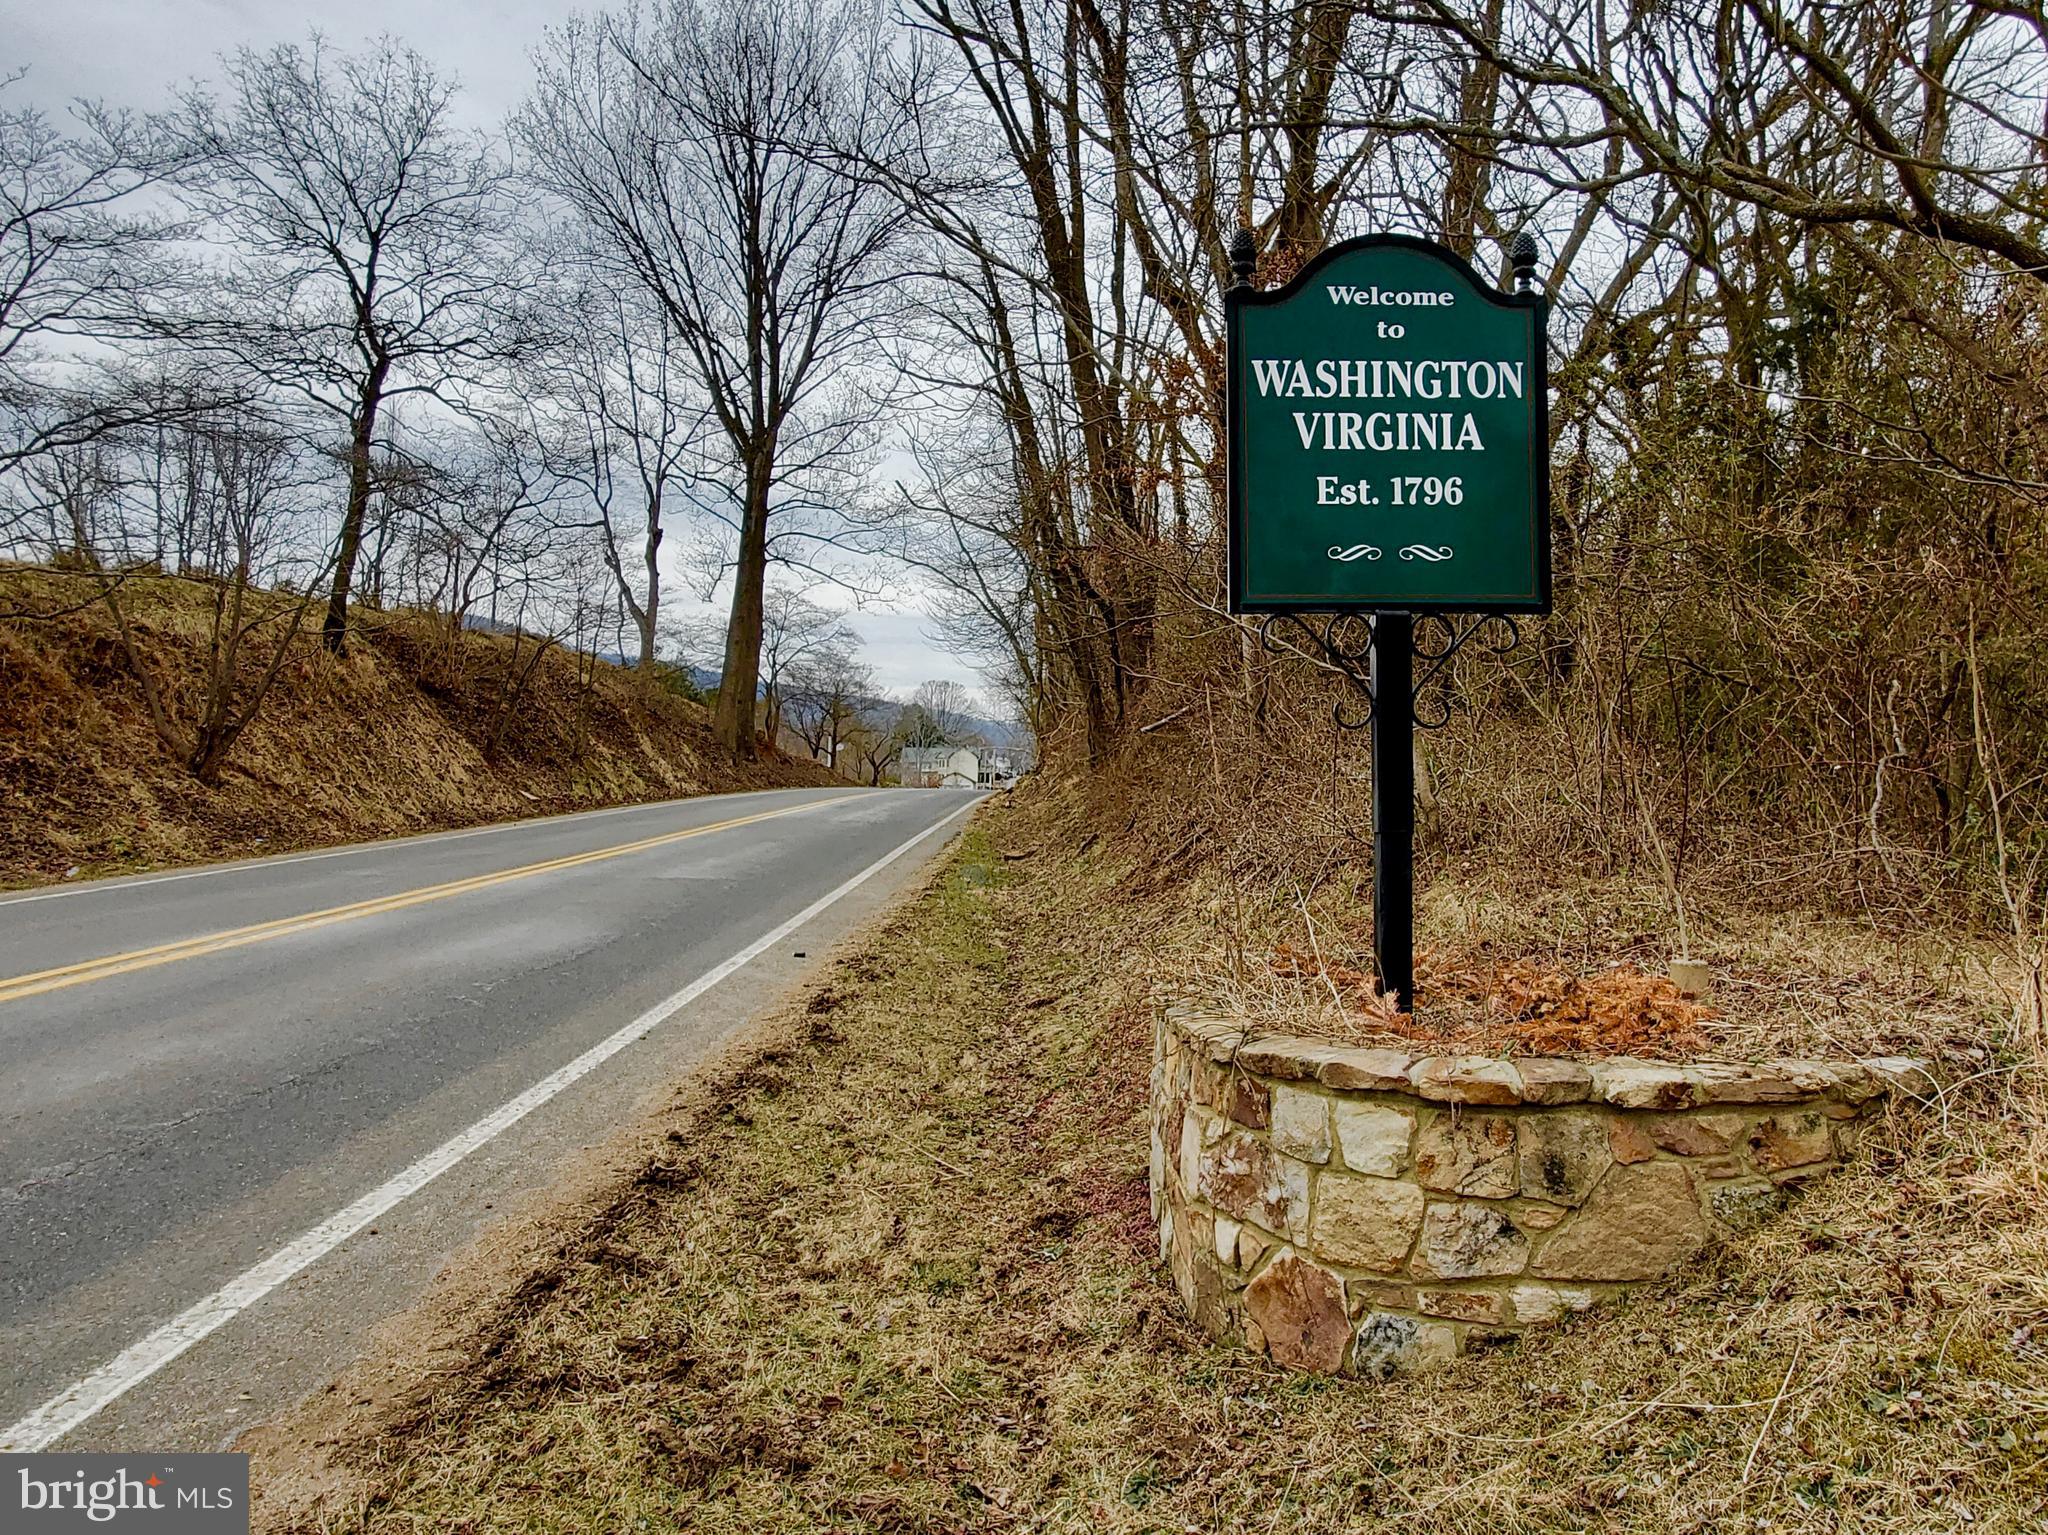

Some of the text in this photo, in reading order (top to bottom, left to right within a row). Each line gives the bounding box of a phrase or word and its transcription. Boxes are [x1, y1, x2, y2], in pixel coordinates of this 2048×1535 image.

[1326, 285, 1455, 306] Welcome
[1377, 321, 1405, 339] to
[1251, 359, 1525, 399] WASHINGTON
[1292, 412, 1485, 451] VIRGINIA
[1316, 476, 1464, 506] Est. 1796
